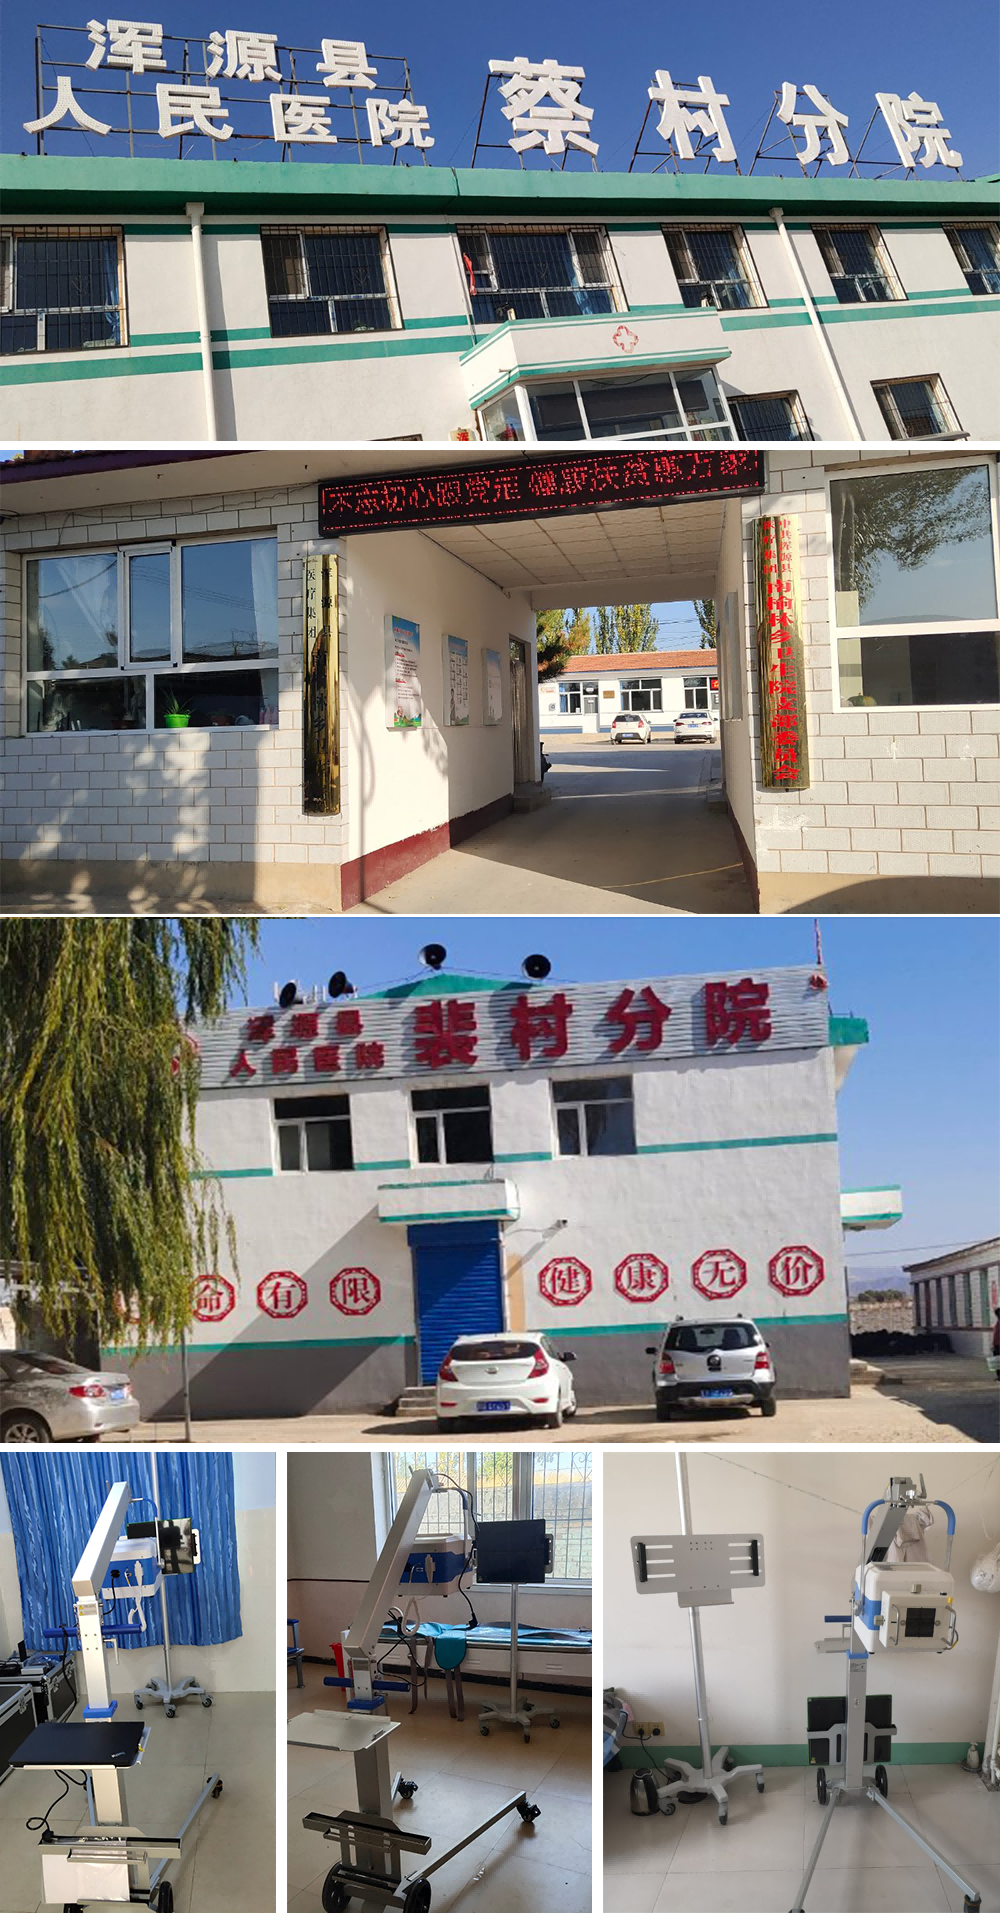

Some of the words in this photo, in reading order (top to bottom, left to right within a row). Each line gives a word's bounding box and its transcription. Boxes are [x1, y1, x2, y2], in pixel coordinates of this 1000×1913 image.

[86, 19, 378, 90] 浑源县
[23, 76, 435, 149] 人民医院
[488, 56, 963, 169] 蔡村分院
[306, 568, 317, 638] 医疗集团
[766, 578, 801, 780] 南榆林乡卫生院支部委员会
[414, 978, 772, 1068] 裴村分院
[550, 1256, 814, 1295] 健康无价
